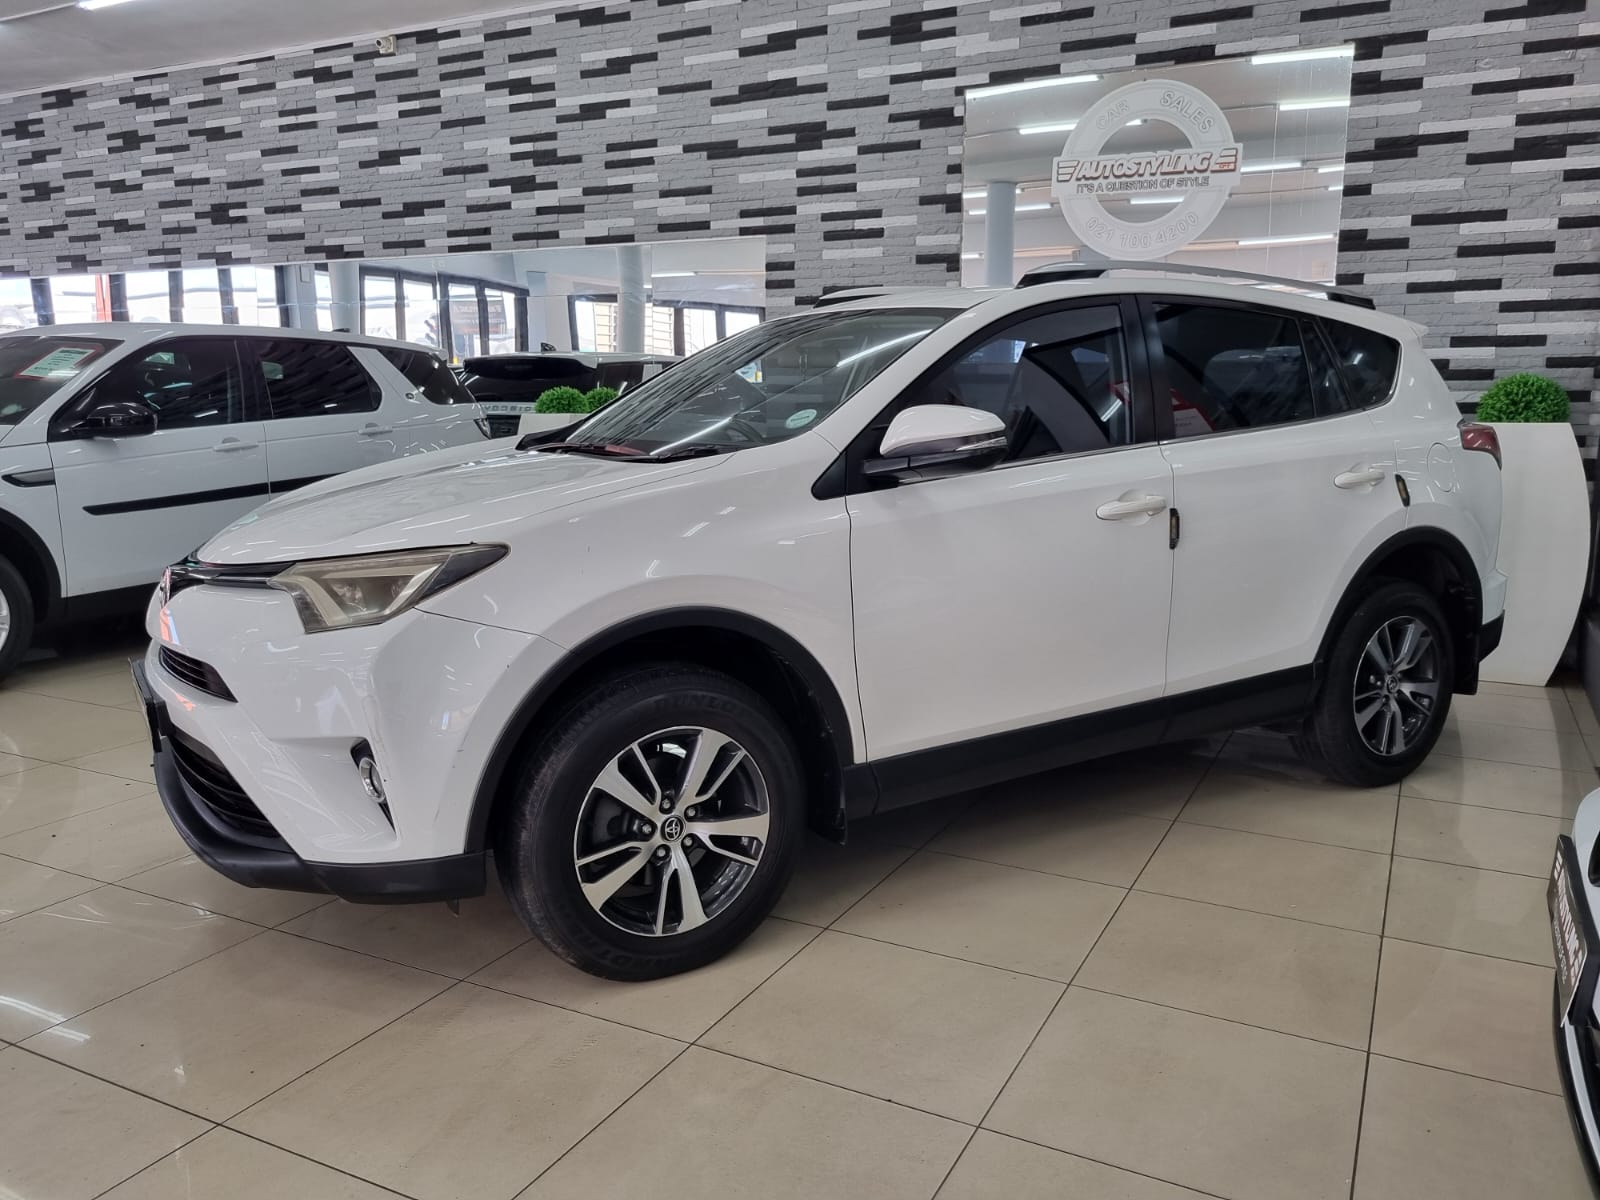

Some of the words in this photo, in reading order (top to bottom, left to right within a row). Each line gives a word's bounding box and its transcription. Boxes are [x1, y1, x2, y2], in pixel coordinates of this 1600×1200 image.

[1096, 99, 1131, 130] CAR
[1160, 90, 1214, 133] SALES
[1076, 153, 1212, 180] AUTOSTYLING
[1077, 184, 1095, 195] IT'S
[1095, 183, 1105, 193] A
[1105, 178, 1158, 193] QUESTION
[1160, 178, 1176, 190] OF
[1177, 176, 1210, 188] STYLE
[1087, 216, 1113, 241] 021
[1156, 211, 1199, 243] 4200
